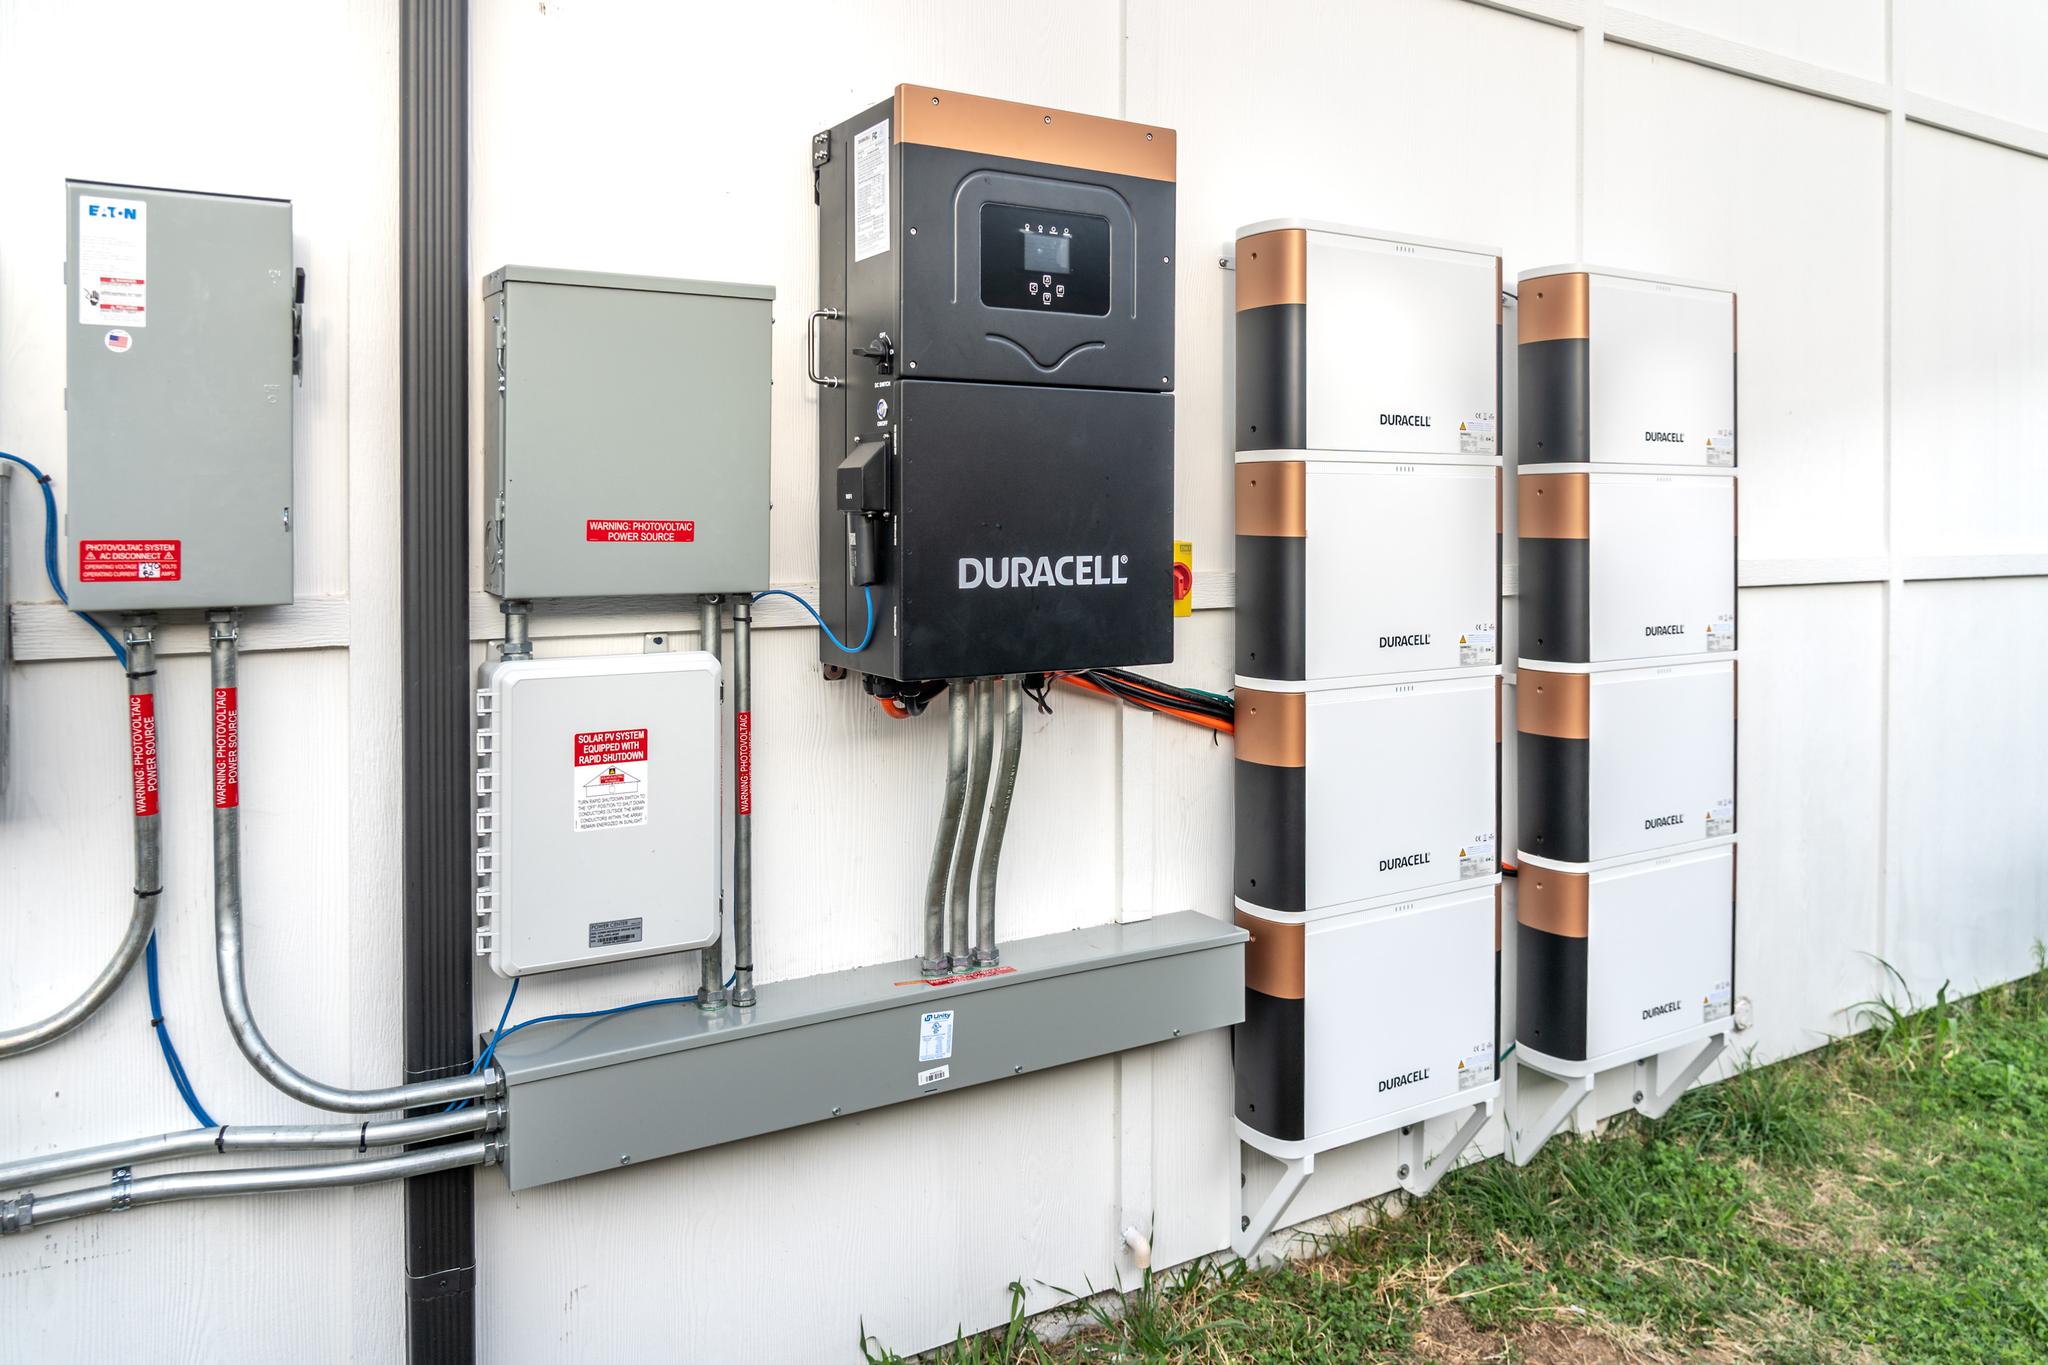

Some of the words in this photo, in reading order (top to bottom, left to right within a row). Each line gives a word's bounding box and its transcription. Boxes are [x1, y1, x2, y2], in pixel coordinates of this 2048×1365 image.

[1380, 414, 1430, 427] DURACELL
[1645, 431, 1684, 443] DURACELL
[590, 521, 631, 531] WARNING:
[633, 522, 692, 531] PHOTOVOLTAIC
[607, 532, 639, 541] POWER
[641, 532, 674, 541] SOURCE
[99, 552, 111, 560] AC
[112, 552, 161, 560] DISCONNECT
[1645, 624, 1684, 636] DURACELL
[1379, 634, 1430, 648] DURACELL
[131, 697, 144, 766] PHOTOVOLTAIC
[215, 690, 227, 758] PHOTOVOLTAIC
[228, 710, 237, 749] SOURCE
[143, 716, 155, 755] SOURCE
[578, 734, 603, 744] SOLAR
[605, 733, 614, 742] PV
[616, 731, 644, 740] SYSTEM
[740, 714, 748, 772] PHOTOVOLTAIC
[579, 754, 601, 764] RAPID
[603, 751, 644, 763] SHUTDOWN
[583, 742, 620, 754] EQUIPPED
[621, 741, 640, 750] WITH
[146, 756, 157, 792] POWER
[228, 750, 238, 784] POWER
[134, 767, 147, 813] WARNING:
[216, 759, 227, 805] WARNING:
[740, 773, 749, 812] WARNING:
[1645, 814, 1684, 830] DURACELL
[1379, 852, 1430, 872] DURACELL
[1642, 1000, 1681, 1020] DURACELL
[1378, 1068, 1430, 1093] DURACELL
